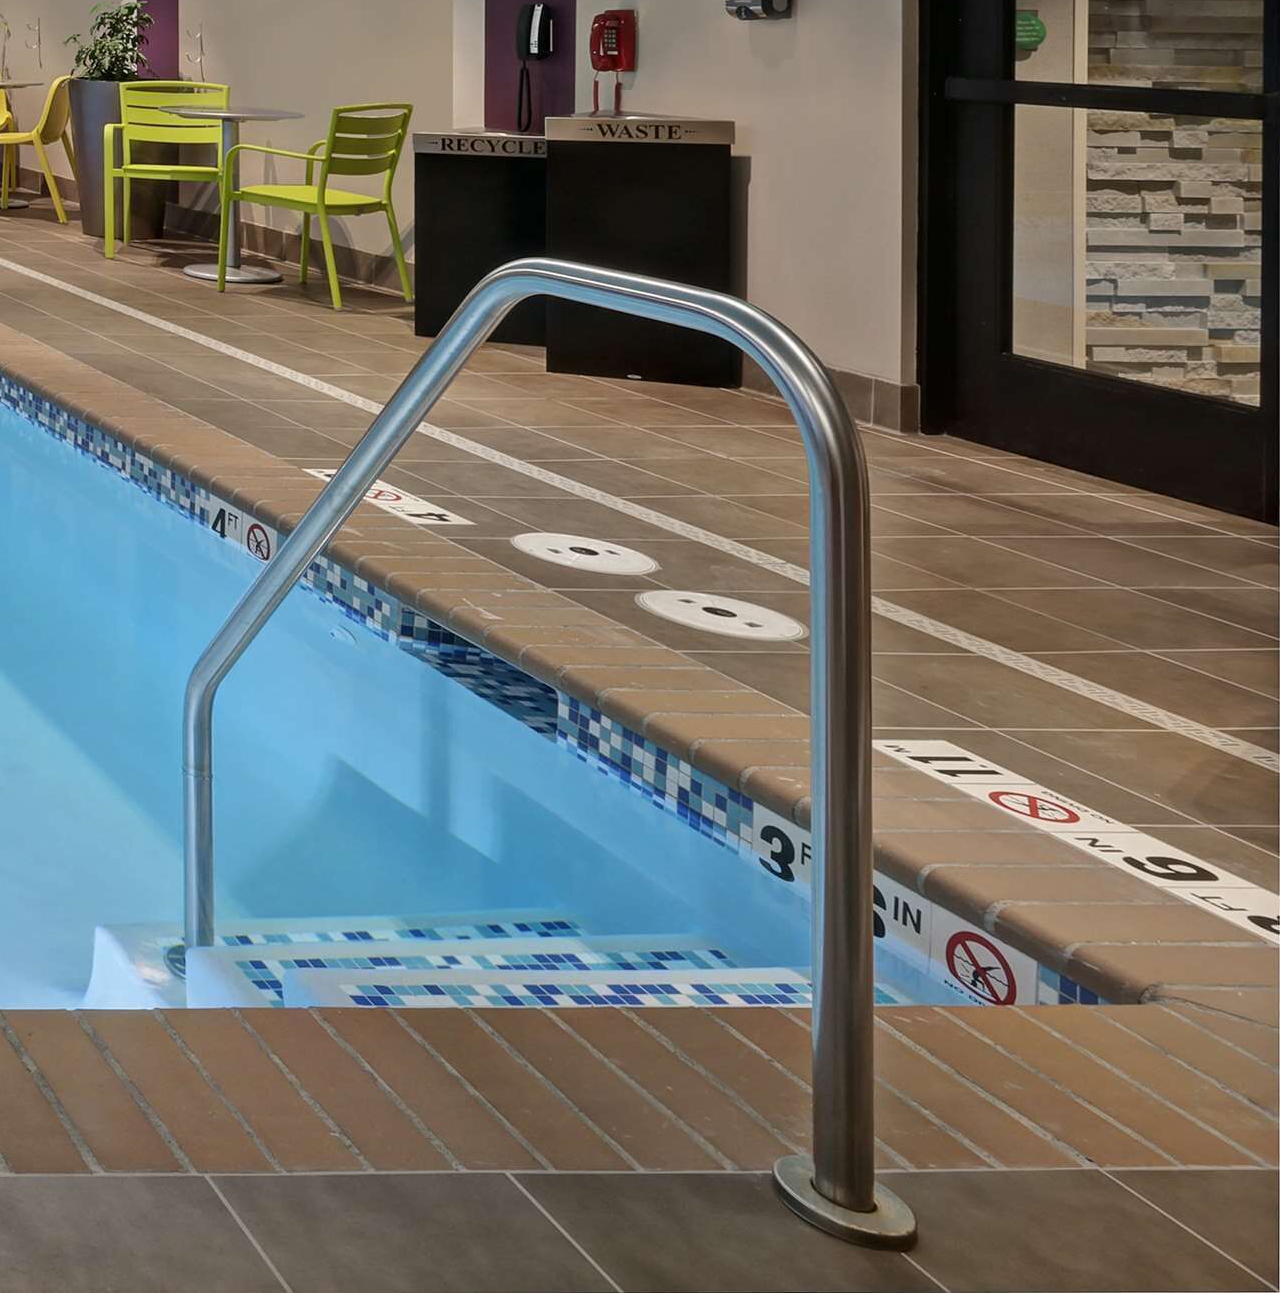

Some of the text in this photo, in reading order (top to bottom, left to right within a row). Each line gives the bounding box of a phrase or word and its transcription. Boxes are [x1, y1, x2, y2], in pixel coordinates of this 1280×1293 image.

[596, 123, 682, 140] WASTE
[440, 137, 546, 154] RECYCLE
[210, 508, 239, 539] 4 FT
[1074, 836, 1220, 882] 6 IN
[759, 825, 796, 882] 3
[801, 842, 812, 866] F
[893, 896, 922, 935] IN
[1190, 892, 1248, 912] FT
